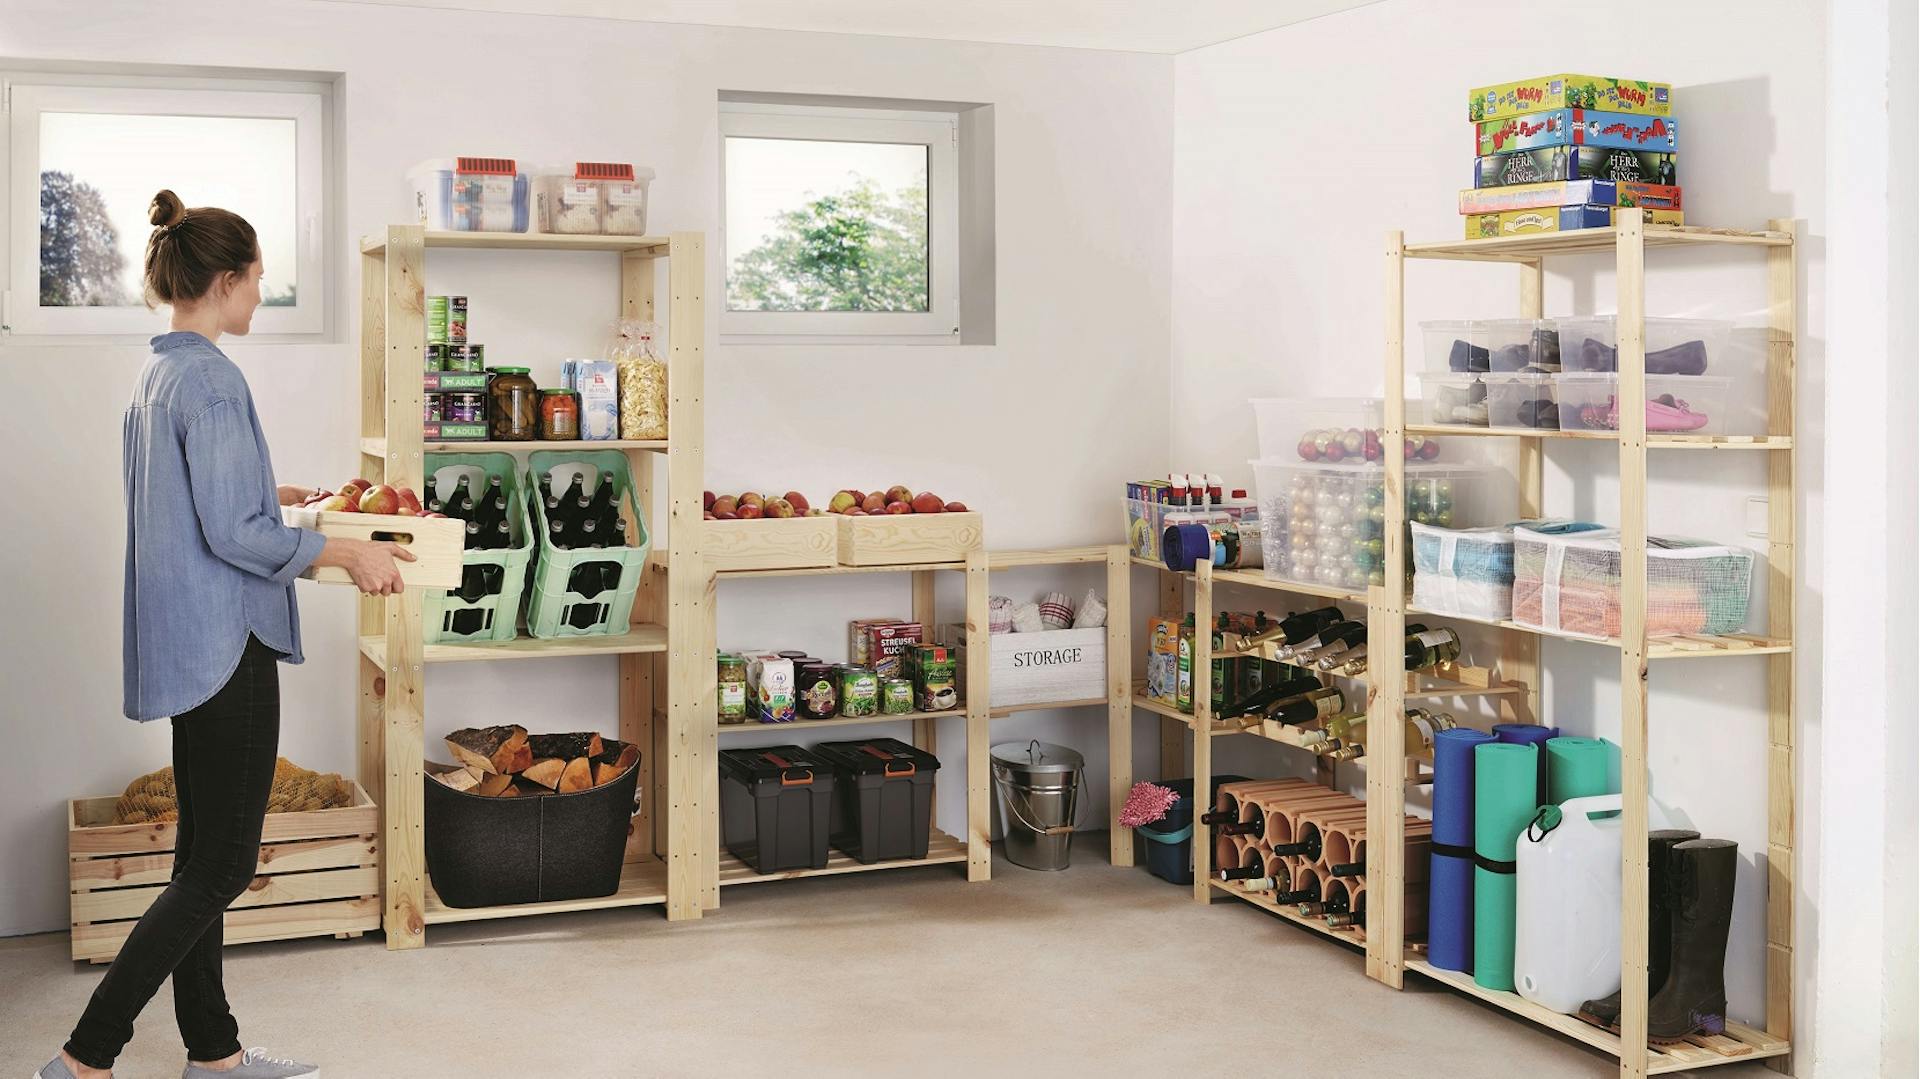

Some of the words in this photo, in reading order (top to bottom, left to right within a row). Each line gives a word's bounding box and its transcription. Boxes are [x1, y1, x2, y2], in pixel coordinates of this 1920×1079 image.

[1508, 155, 1533, 169] HERR
[1610, 154, 1639, 168] HERR
[1507, 171, 1533, 184] RINGE
[1610, 170, 1639, 182] RINGE
[455, 379, 483, 387] ADULT
[456, 428, 483, 436] ADULT
[881, 637, 916, 647] STREUSEL
[883, 646, 905, 655] KUCH
[1014, 648, 1082, 667] STORAGE
